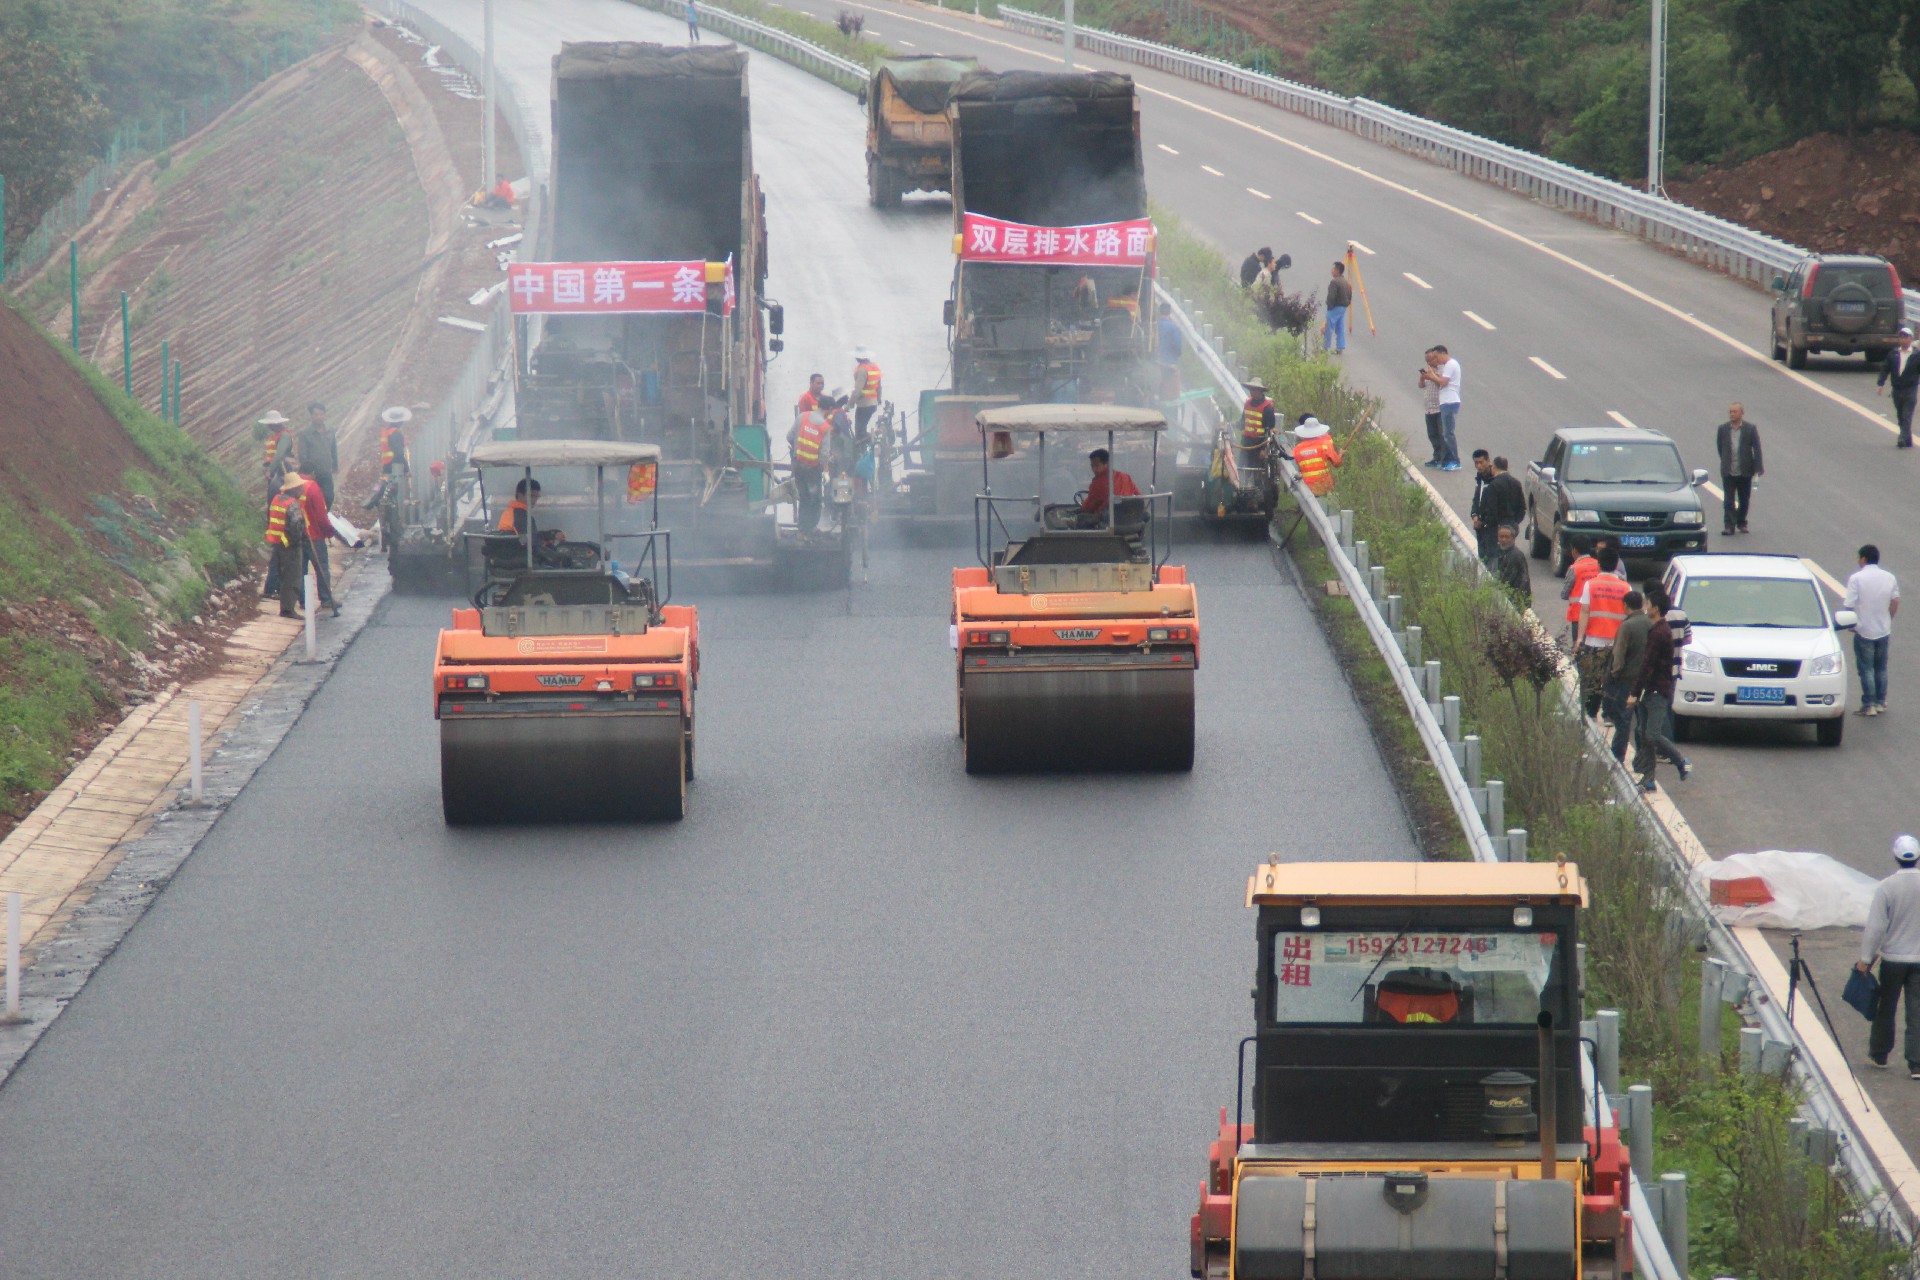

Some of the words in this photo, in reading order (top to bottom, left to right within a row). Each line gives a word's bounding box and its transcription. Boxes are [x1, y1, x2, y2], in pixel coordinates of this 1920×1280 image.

[970, 223, 1149, 258] 双层排水路面
[513, 266, 705, 305] 中国第一条
[1060, 630, 1096, 640] HAMM
[1746, 663, 1778, 672] JMC
[543, 674, 578, 686] HAMM
[1280, 935, 1312, 987] 出租
